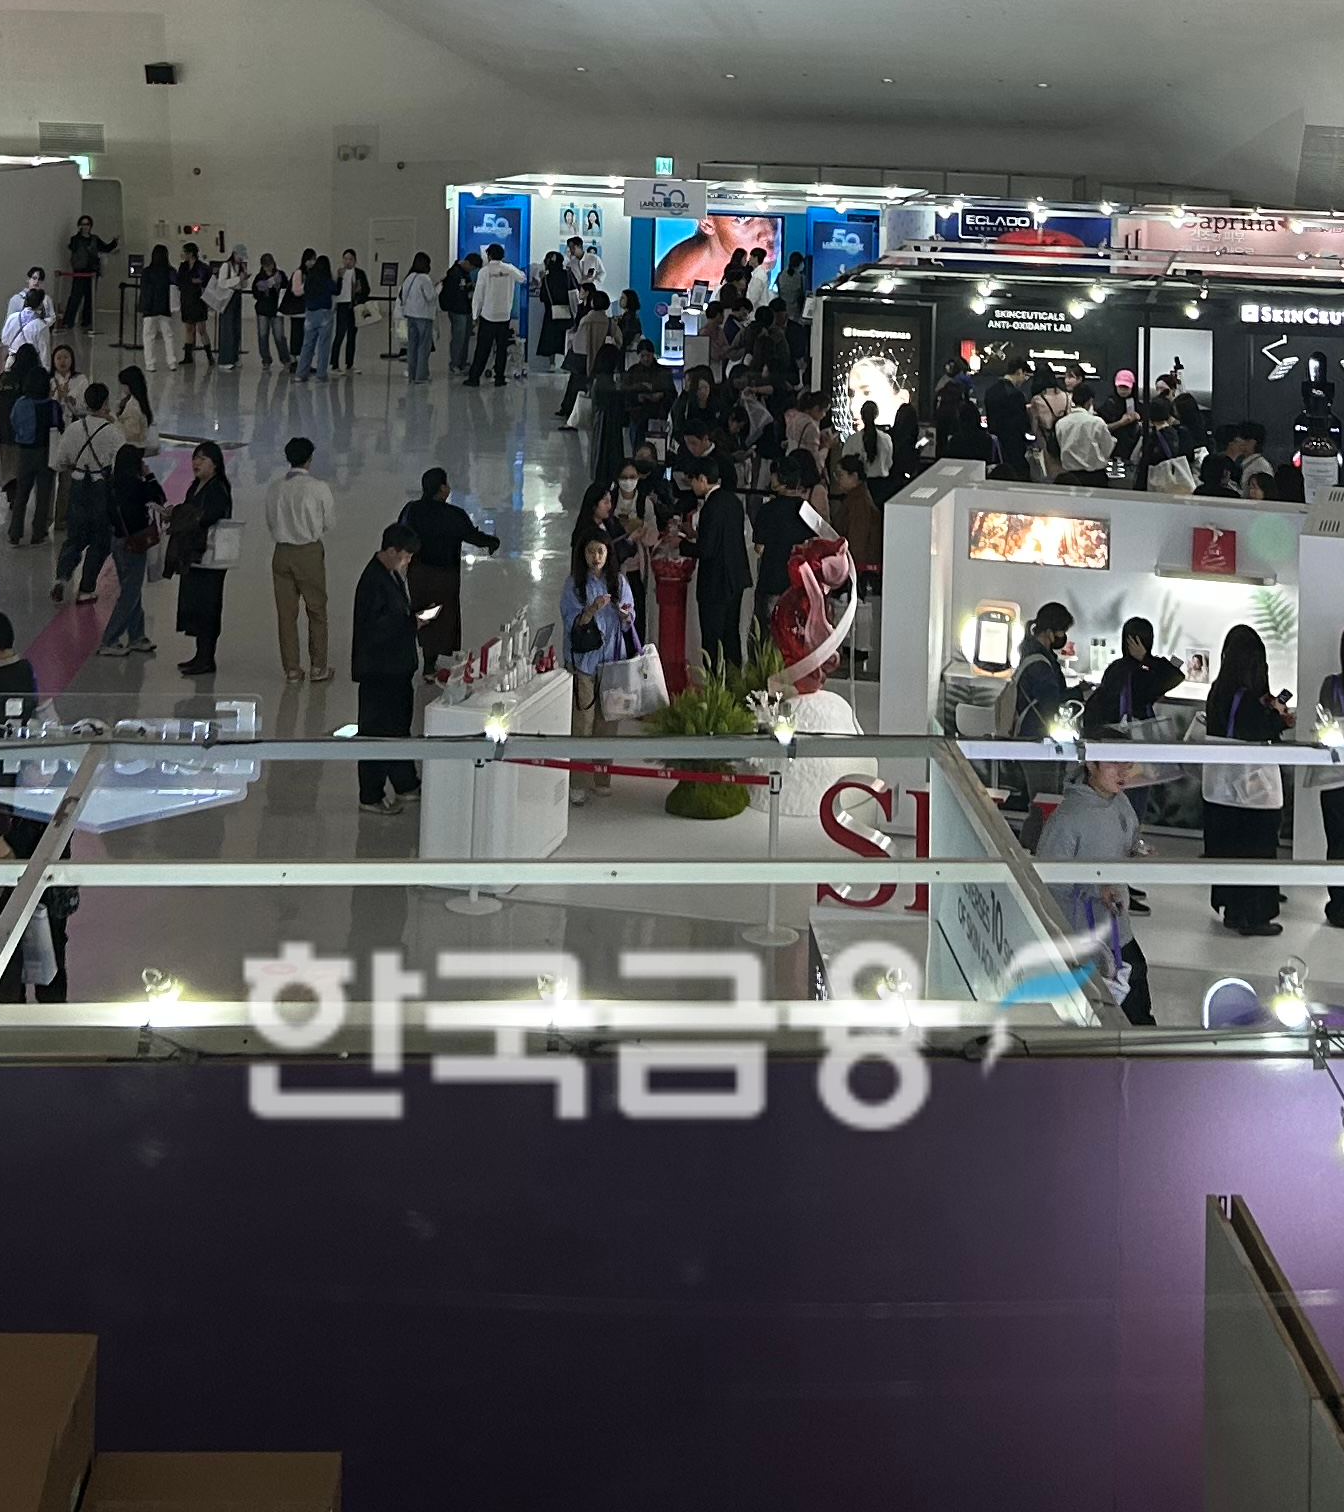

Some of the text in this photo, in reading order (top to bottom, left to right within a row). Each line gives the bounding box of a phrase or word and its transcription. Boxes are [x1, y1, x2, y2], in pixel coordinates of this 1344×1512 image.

[965, 214, 1030, 227] ECLADO
[994, 310, 1065, 322] SKINCEUTICALS
[987, 320, 1072, 333] ANTI-OXIDANT LAB
